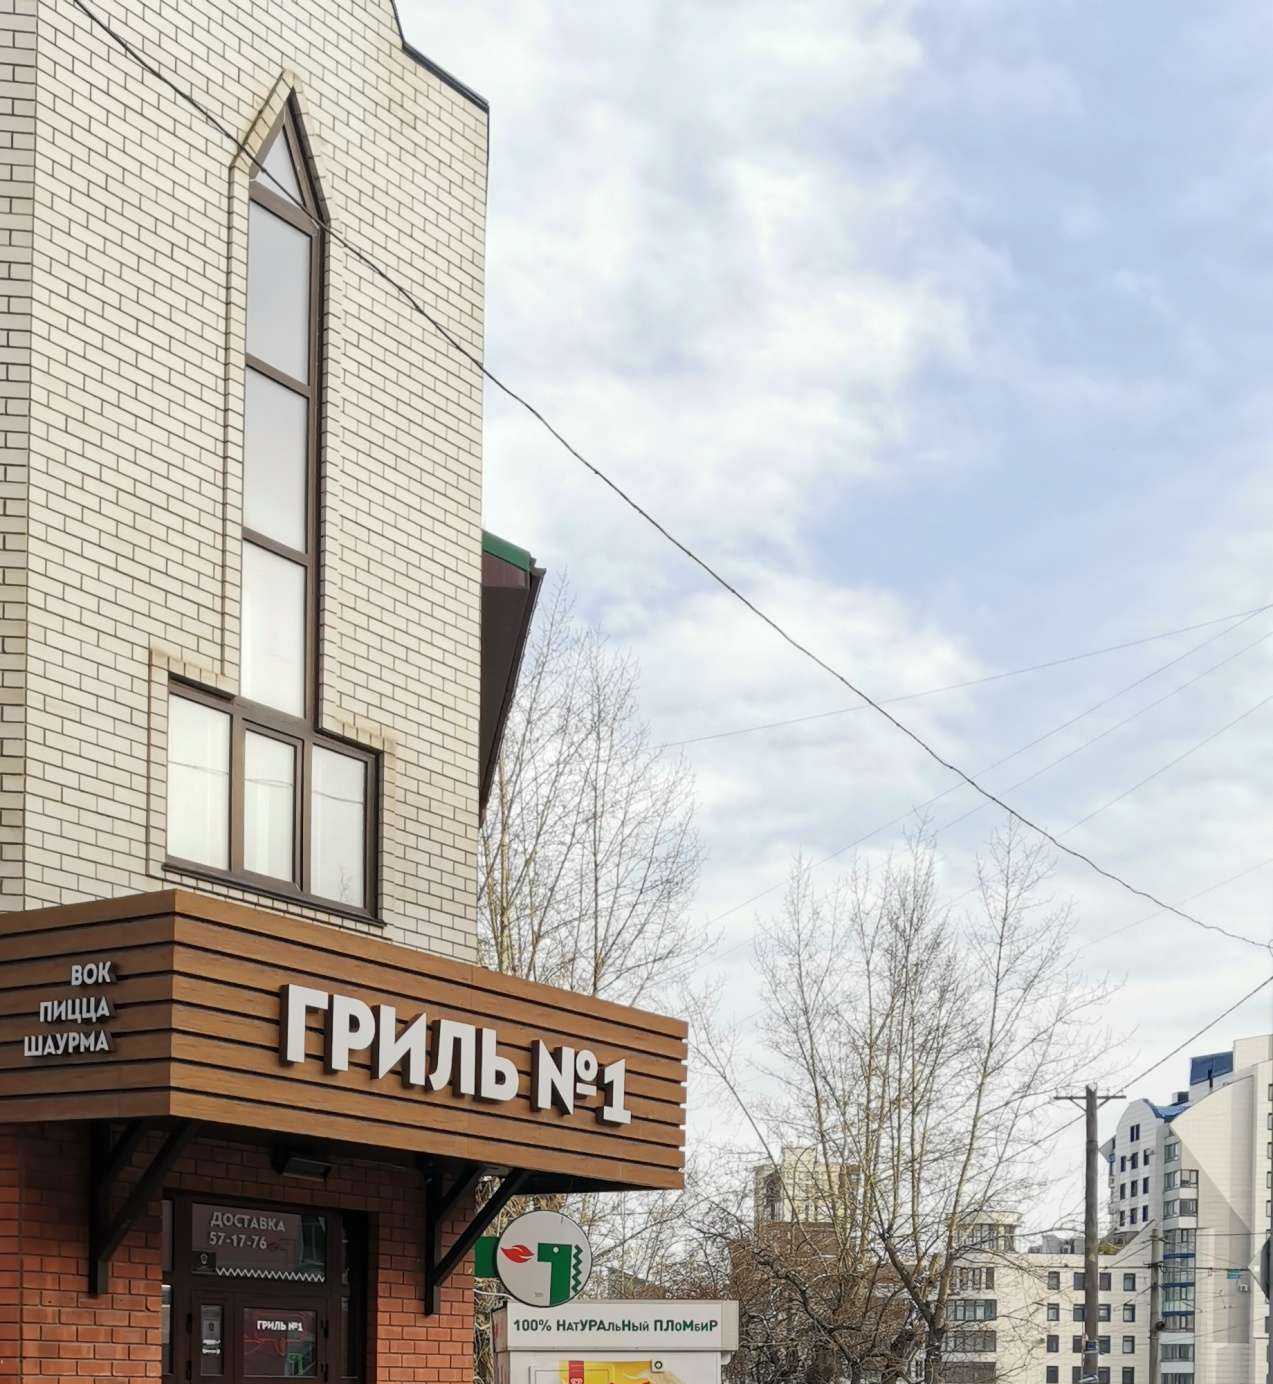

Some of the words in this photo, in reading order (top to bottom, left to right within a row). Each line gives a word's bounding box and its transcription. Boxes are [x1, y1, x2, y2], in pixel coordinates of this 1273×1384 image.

[71, 961, 112, 986] ВОК
[39, 996, 110, 1024] ПИЦЦА
[24, 1029, 109, 1057] ШАУРМА
[285, 983, 519, 1101] ГРИЛЬ
[537, 1039, 632, 1124] №1
[210, 1211, 286, 1232] ДОСТАВКА
[209, 1231, 267, 1250] 57-17-76
[257, 1320, 287, 1331] ГРИЛЬ
[513, 1319, 552, 1332] 100%
